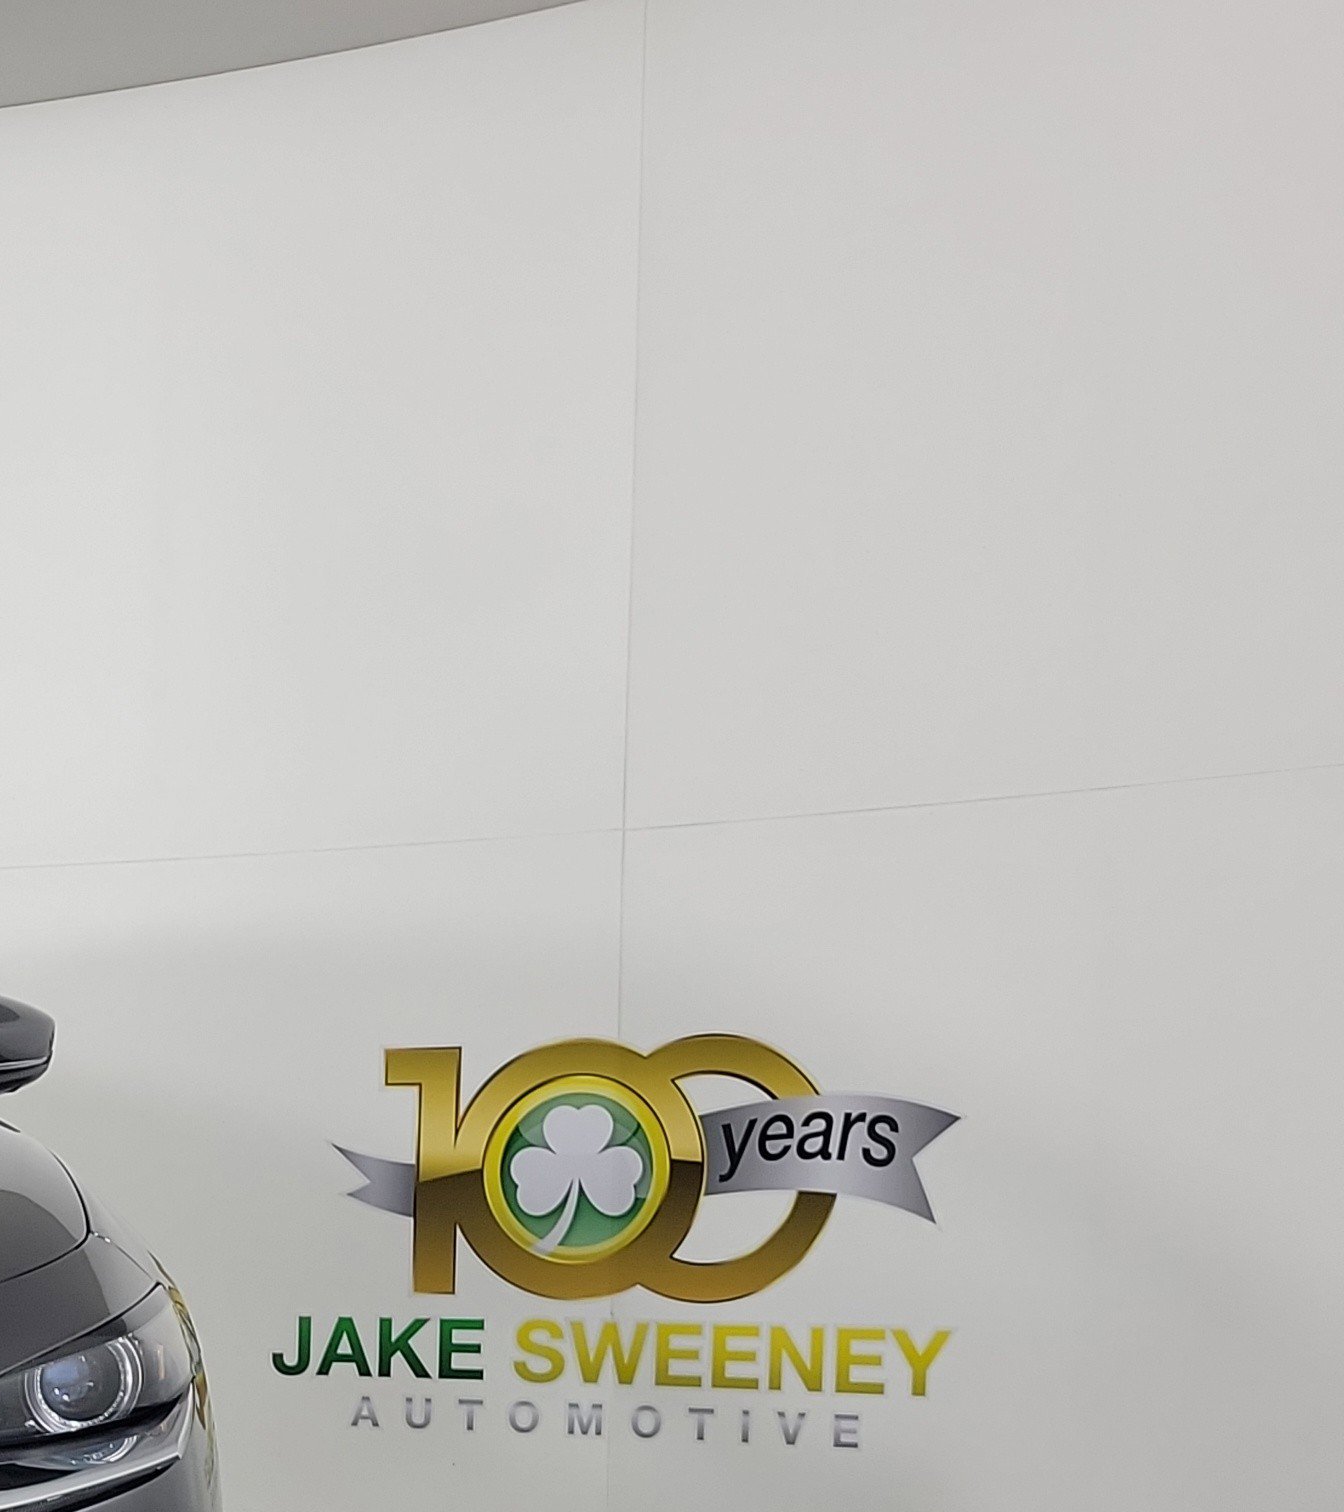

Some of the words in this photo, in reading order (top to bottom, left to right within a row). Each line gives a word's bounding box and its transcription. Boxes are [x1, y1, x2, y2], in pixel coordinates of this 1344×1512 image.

[384, 1032, 838, 1304] 100
[716, 1108, 900, 1183] years
[270, 1315, 486, 1381] JAKE
[512, 1318, 953, 1397] SWEENEY
[350, 1396, 861, 1449] AUTOMOTIVE
